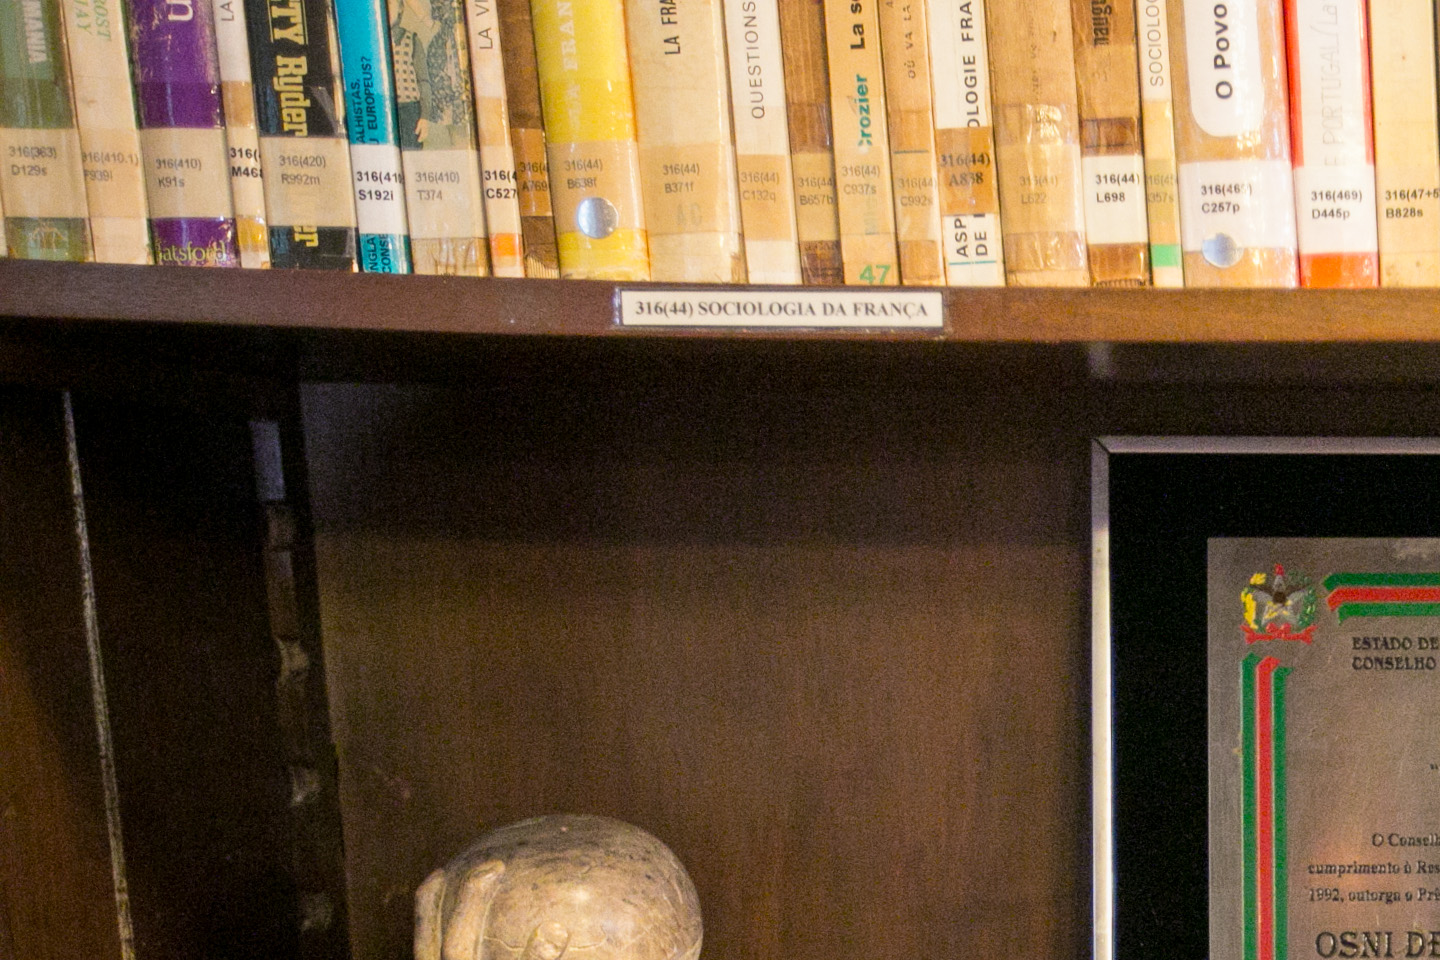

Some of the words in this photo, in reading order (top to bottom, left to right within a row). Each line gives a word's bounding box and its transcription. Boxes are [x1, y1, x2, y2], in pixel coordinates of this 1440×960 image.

[478, 27, 494, 50] LA
[850, 23, 866, 50] La
[1213, 3, 1231, 70] Povo
[663, 35, 681, 55] LA
[742, 1, 766, 120] QUESTIONS
[272, 55, 311, 137] Ryder
[361, 56, 378, 131] EUROPEUS?
[1215, 81, 1234, 99] O
[155, 158, 202, 171] 316(410)
[279, 155, 327, 168] 316(420)
[564, 159, 604, 173] 316(44)
[941, 153, 990, 168] 316(44)
[11, 164, 48, 176] D129s
[662, 163, 700, 177] 316(44)
[842, 165, 881, 178] 316(44)
[158, 176, 185, 188] K91s
[281, 173, 321, 185] R992m
[415, 171, 460, 184] 316(410)
[741, 171, 780, 185] 316(44)
[950, 173, 984, 187] A838
[1095, 174, 1140, 186] 316(44)
[418, 189, 443, 200] T374
[664, 182, 694, 194] B371f
[843, 183, 876, 195] C937s
[358, 190, 394, 201] S192i
[743, 189, 776, 204] C132q
[1096, 192, 1126, 203] L698
[1311, 190, 1363, 203] 316(469)
[1201, 201, 1240, 214] C257p
[1312, 208, 1351, 220] D445p
[1385, 207, 1424, 219] B828s
[974, 231, 988, 257] DE
[859, 265, 891, 284] 47
[635, 300, 694, 319] 316(44)
[698, 301, 816, 317] SOCIOLOGIA
[822, 302, 848, 317] DA
[853, 301, 929, 320] FRANÇA
[1352, 637, 1412, 650] ESTADO
[1418, 637, 1438, 649] DE
[1352, 656, 1437, 670] CONSELHO
[1372, 833, 1384, 847] O
[1308, 861, 1400, 878] cumprimento
[1308, 888, 1345, 903] 1992,
[1348, 889, 1401, 905] outorga
[1405, 892, 1413, 901] o
[1315, 931, 1394, 959] OSNI
